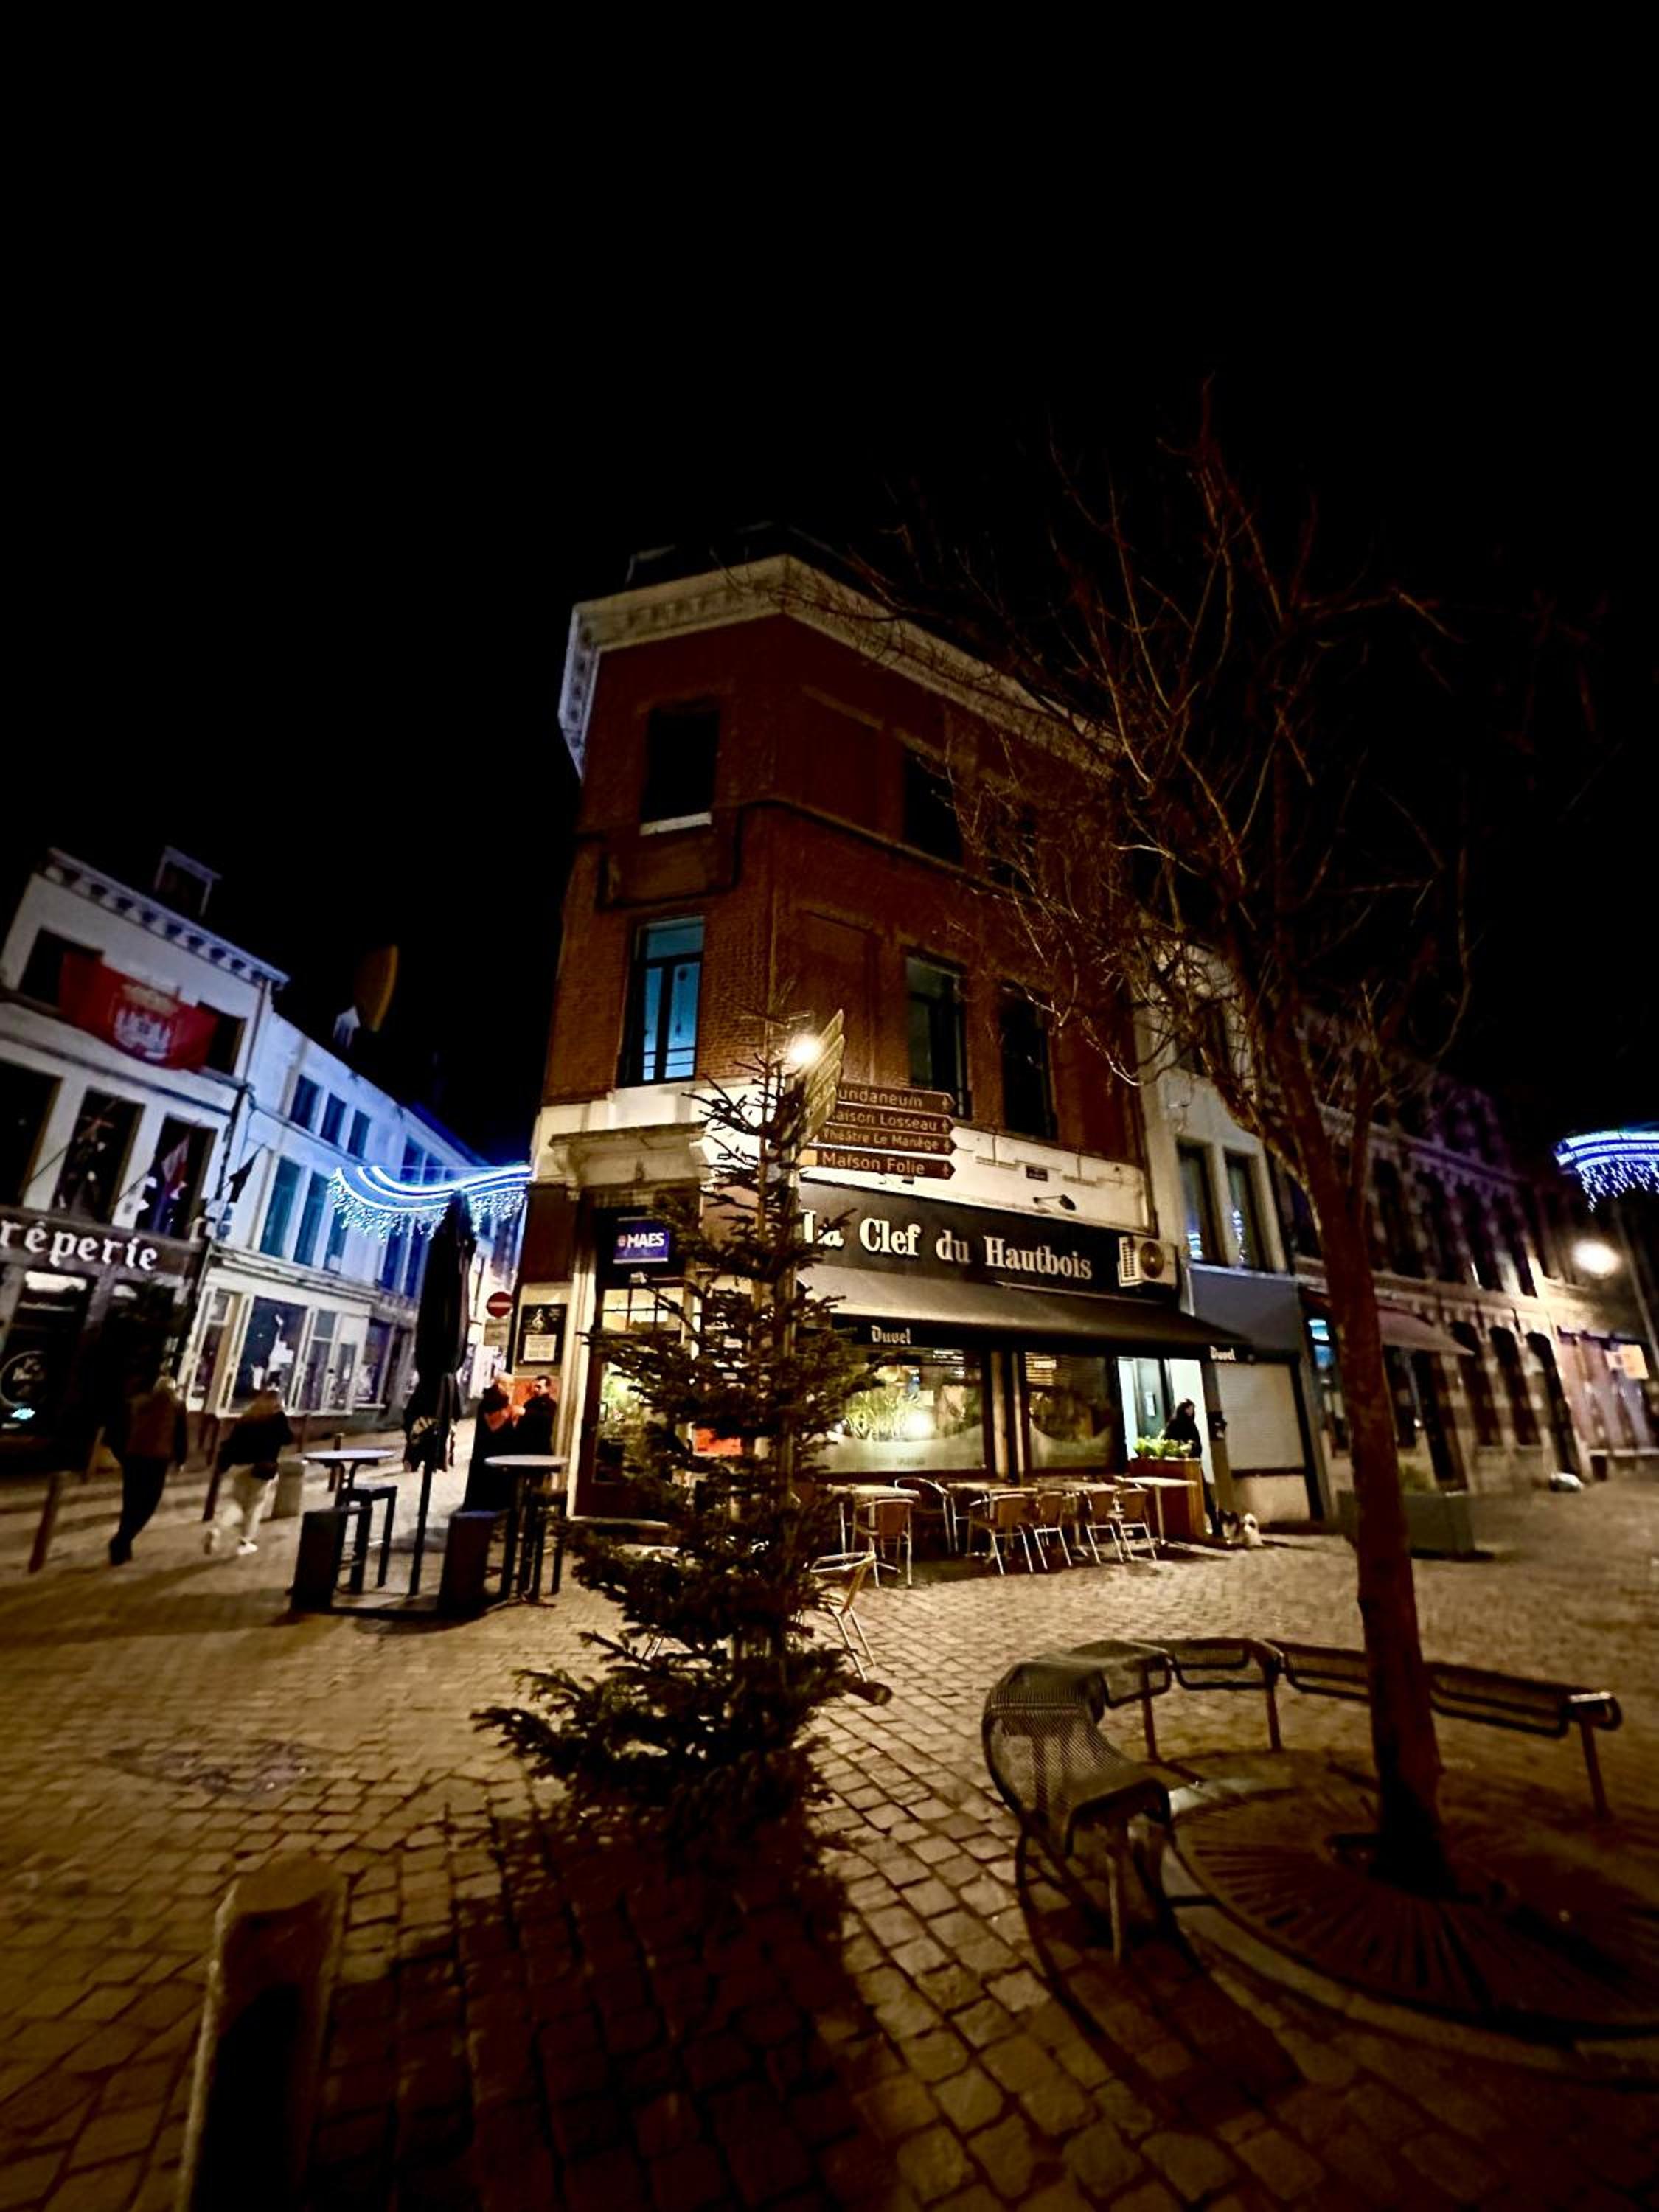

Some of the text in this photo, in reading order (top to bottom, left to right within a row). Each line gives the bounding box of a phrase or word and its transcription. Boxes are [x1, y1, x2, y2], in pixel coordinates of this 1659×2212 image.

[838, 1088, 922, 1107] undaneum
[832, 1109, 937, 1132] aison Losseau
[823, 1127, 939, 1151] Théâtre Le Manège
[822, 1150, 925, 1175] Maison Folie
[627, 1232, 665, 1248] MAES
[859, 1217, 921, 1256] Clef
[936, 1229, 970, 1263] du
[983, 1235, 1093, 1279] Hautbois
[871, 1324, 911, 1345] Duvel
